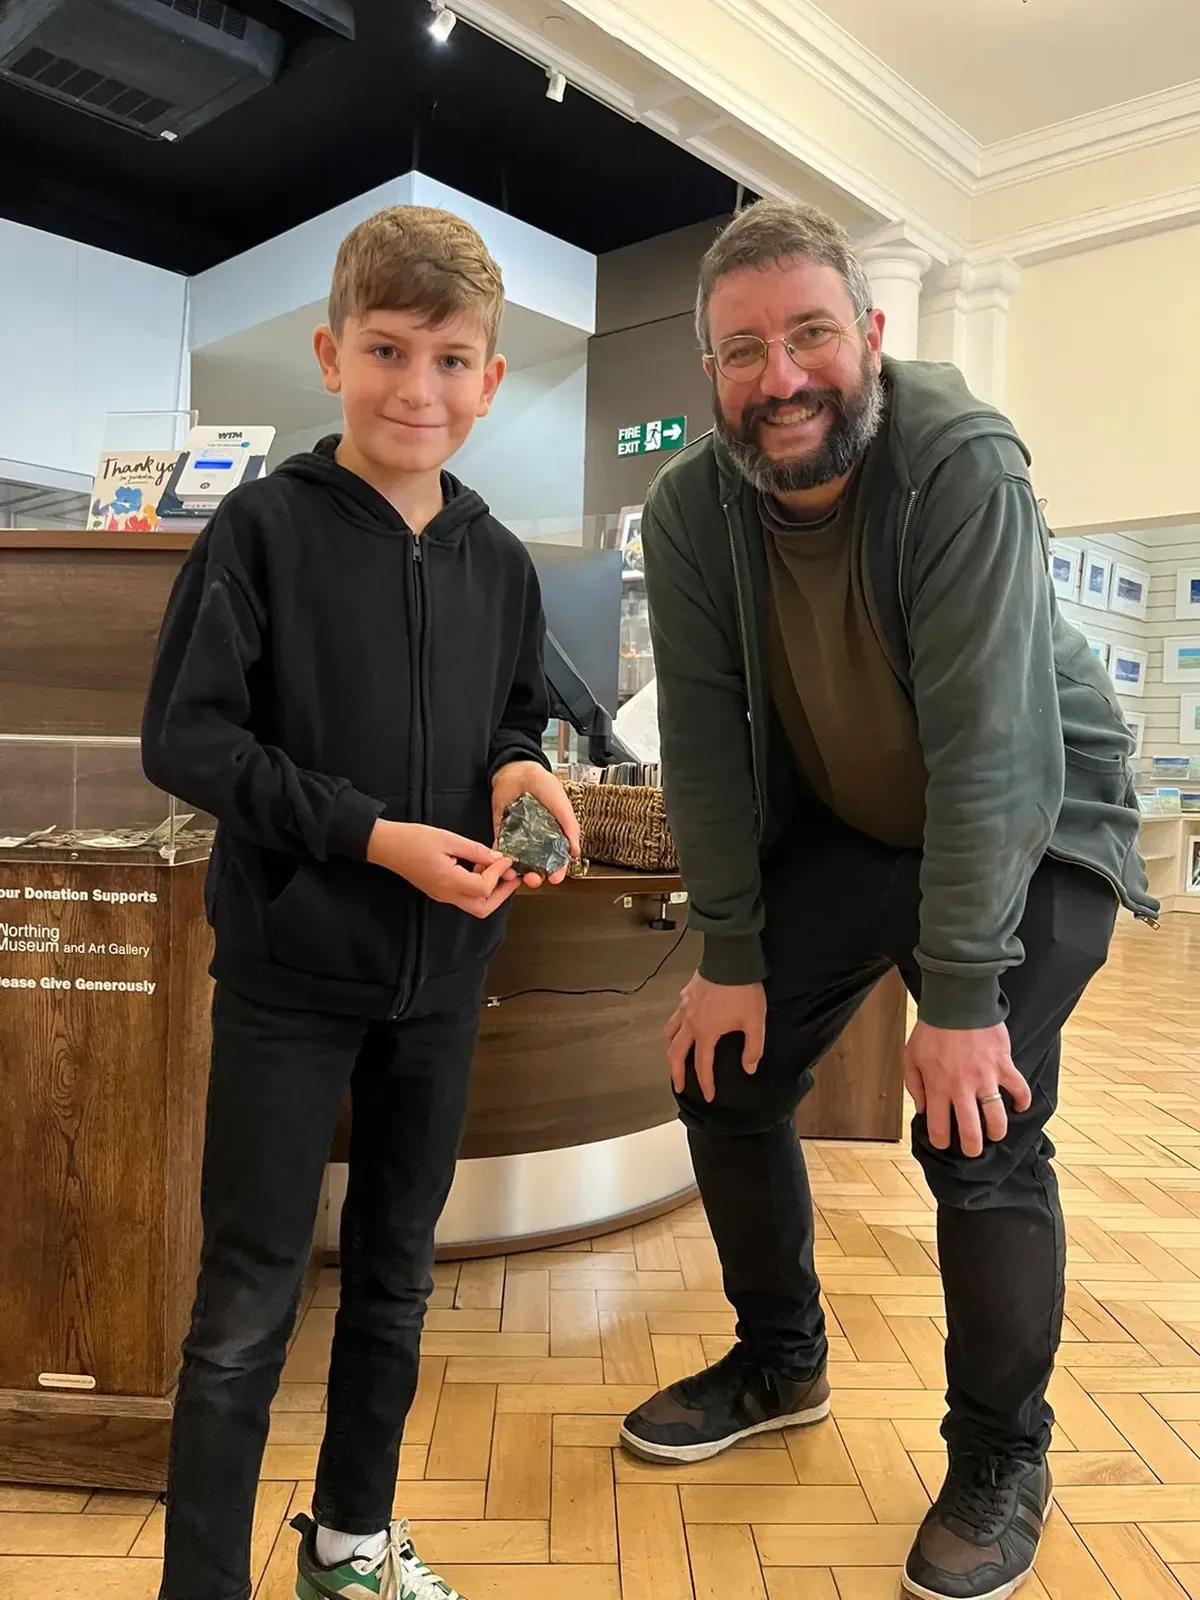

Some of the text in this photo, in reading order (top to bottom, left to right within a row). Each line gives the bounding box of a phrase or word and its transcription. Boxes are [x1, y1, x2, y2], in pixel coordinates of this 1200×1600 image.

[618, 426, 641, 440] FIRE
[617, 441, 640, 455] EXIT
[103, 455, 177, 486] Thank yo
[0, 887, 158, 904] our Donation Supports
[63, 942, 86, 954] and
[88, 942, 106, 954] Art
[108, 943, 150, 958] Gallery
[0, 976, 156, 995] ease Give Generously
